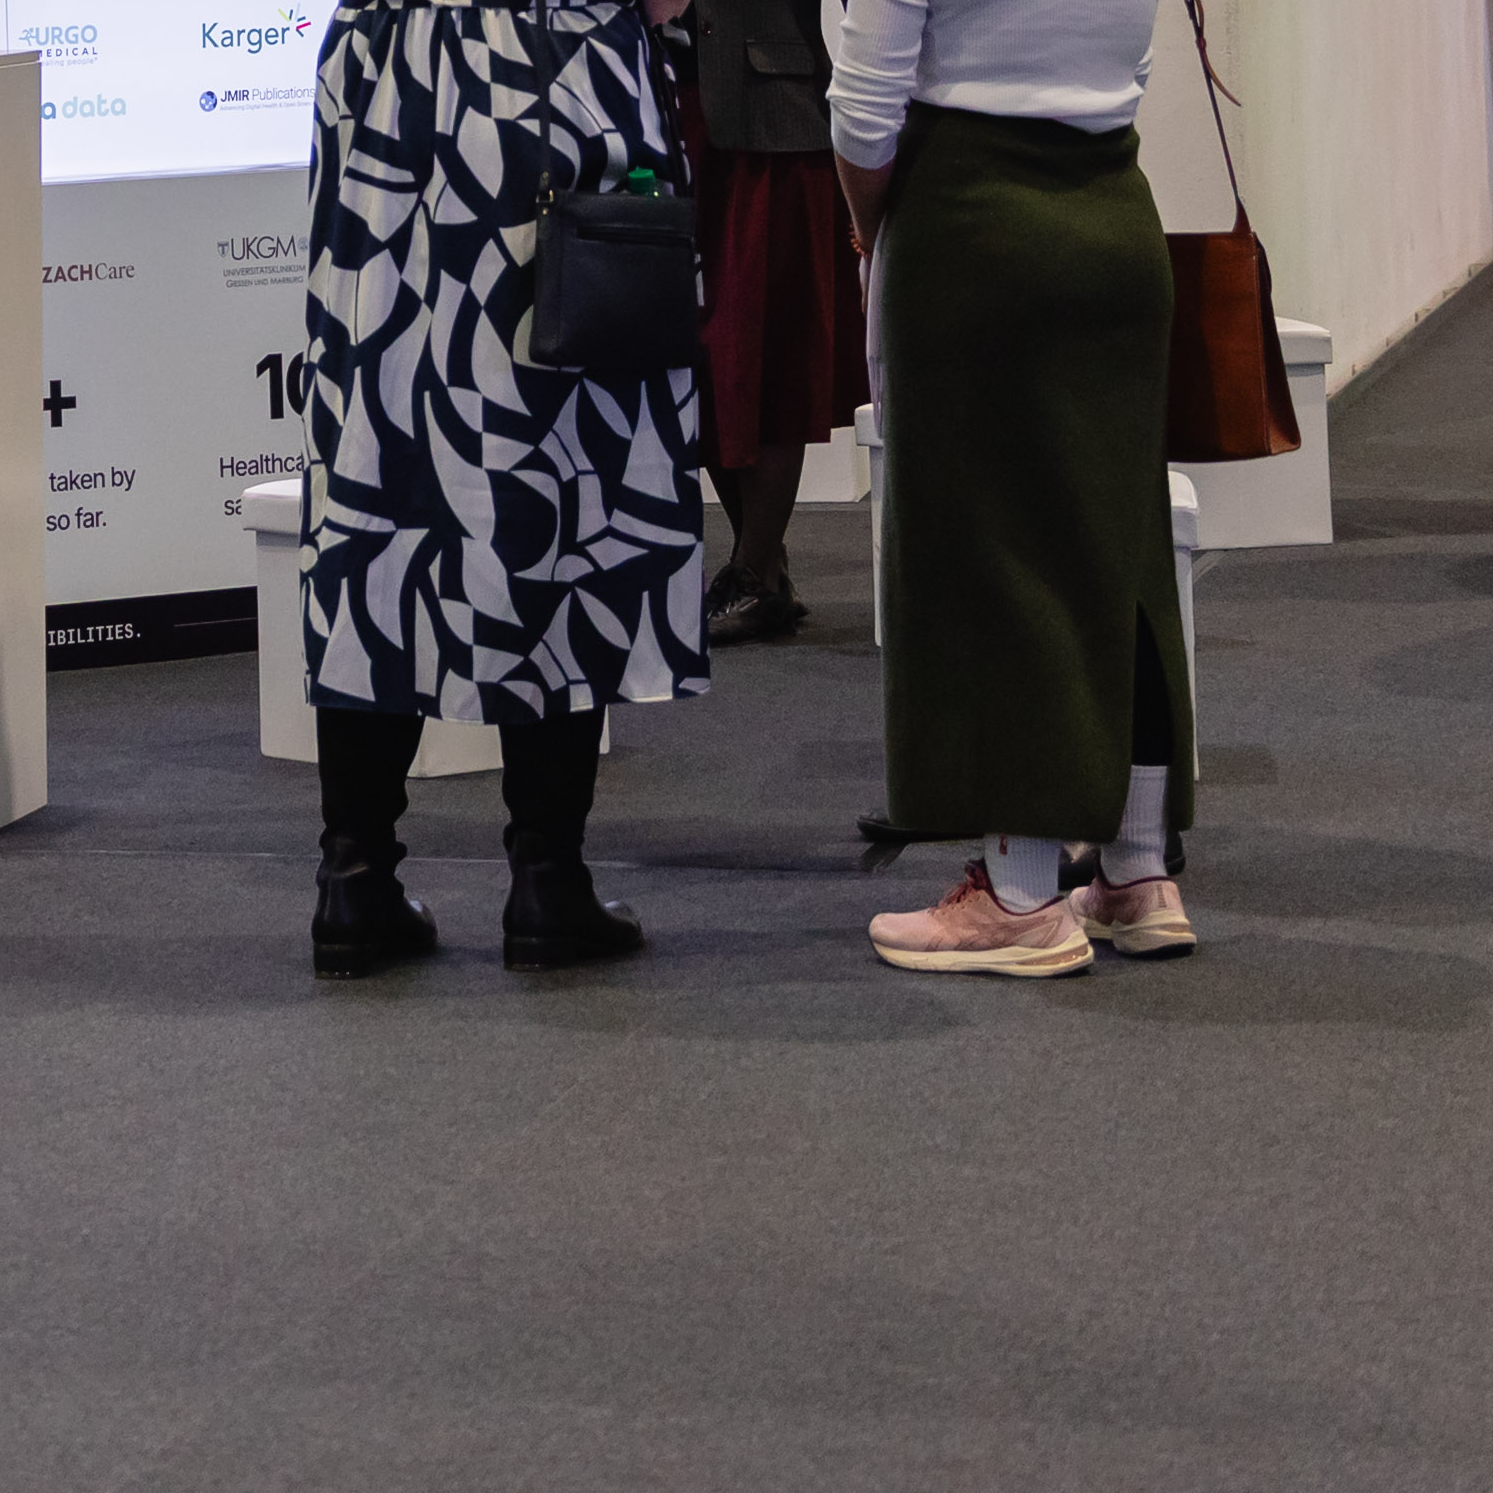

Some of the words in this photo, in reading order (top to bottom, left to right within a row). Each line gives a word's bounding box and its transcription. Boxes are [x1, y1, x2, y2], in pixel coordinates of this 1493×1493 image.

[35, 25, 97, 45] URGO
[202, 23, 290, 54] Karger
[62, 94, 126, 118] data
[220, 90, 249, 102] JMIR
[252, 87, 316, 101] Publications
[231, 235, 296, 260] UKGM
[42, 262, 136, 284] ZACHCare
[49, 469, 106, 493] taken
[111, 467, 136, 492] by
[46, 511, 71, 531] so
[75, 508, 106, 529] far.
